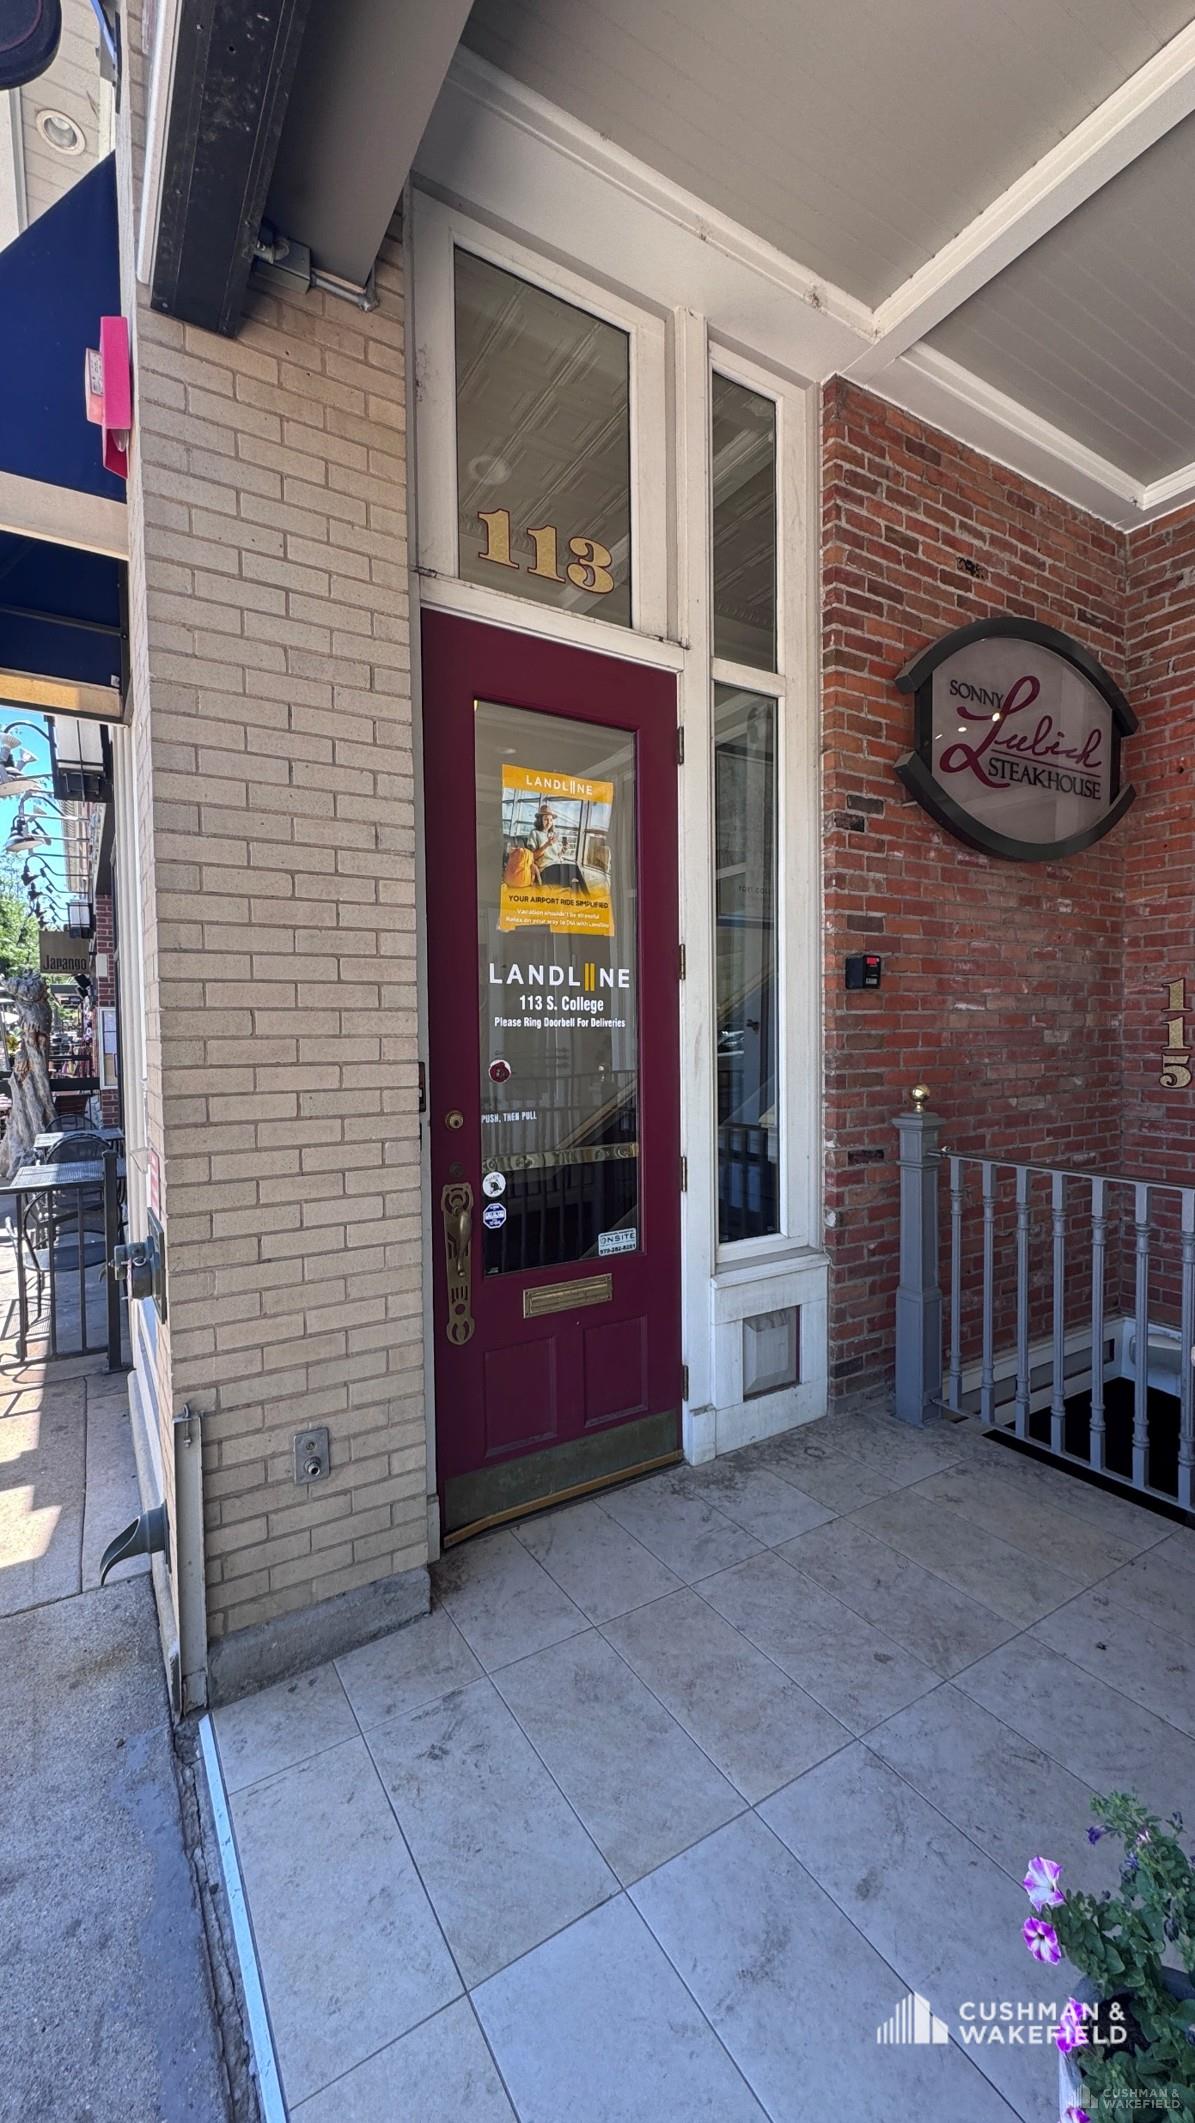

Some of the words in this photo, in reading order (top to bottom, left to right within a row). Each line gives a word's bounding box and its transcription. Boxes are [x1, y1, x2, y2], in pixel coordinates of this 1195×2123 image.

[477, 508, 615, 594] 113
[950, 679, 1004, 709] SONNY
[939, 675, 1103, 789] Lubick
[526, 774, 593, 796] LANDLINE
[988, 757, 1102, 800] STEAKHOUSE
[509, 895, 529, 903] YOUR
[530, 896, 559, 905] AIRPORT
[575, 901, 609, 909] SIMPLIFIED
[43, 954, 88, 971] Japango
[489, 962, 630, 992] LANDLINE
[519, 994, 543, 1011] 113
[546, 995, 558, 1011] S.
[561, 996, 604, 1013] College
[494, 1016, 522, 1028] Please
[523, 1017, 542, 1029] Ring
[543, 1017, 576, 1028] Doorbell
[577, 1017, 589, 1028] For
[590, 1017, 626, 1028] Deliveries
[1159, 977, 1193, 1089] 115
[481, 1112, 502, 1124] PUSH,
[503, 1111, 520, 1123] THEN
[521, 1110, 537, 1121] PULL
[600, 1233, 635, 1245] ONSITE
